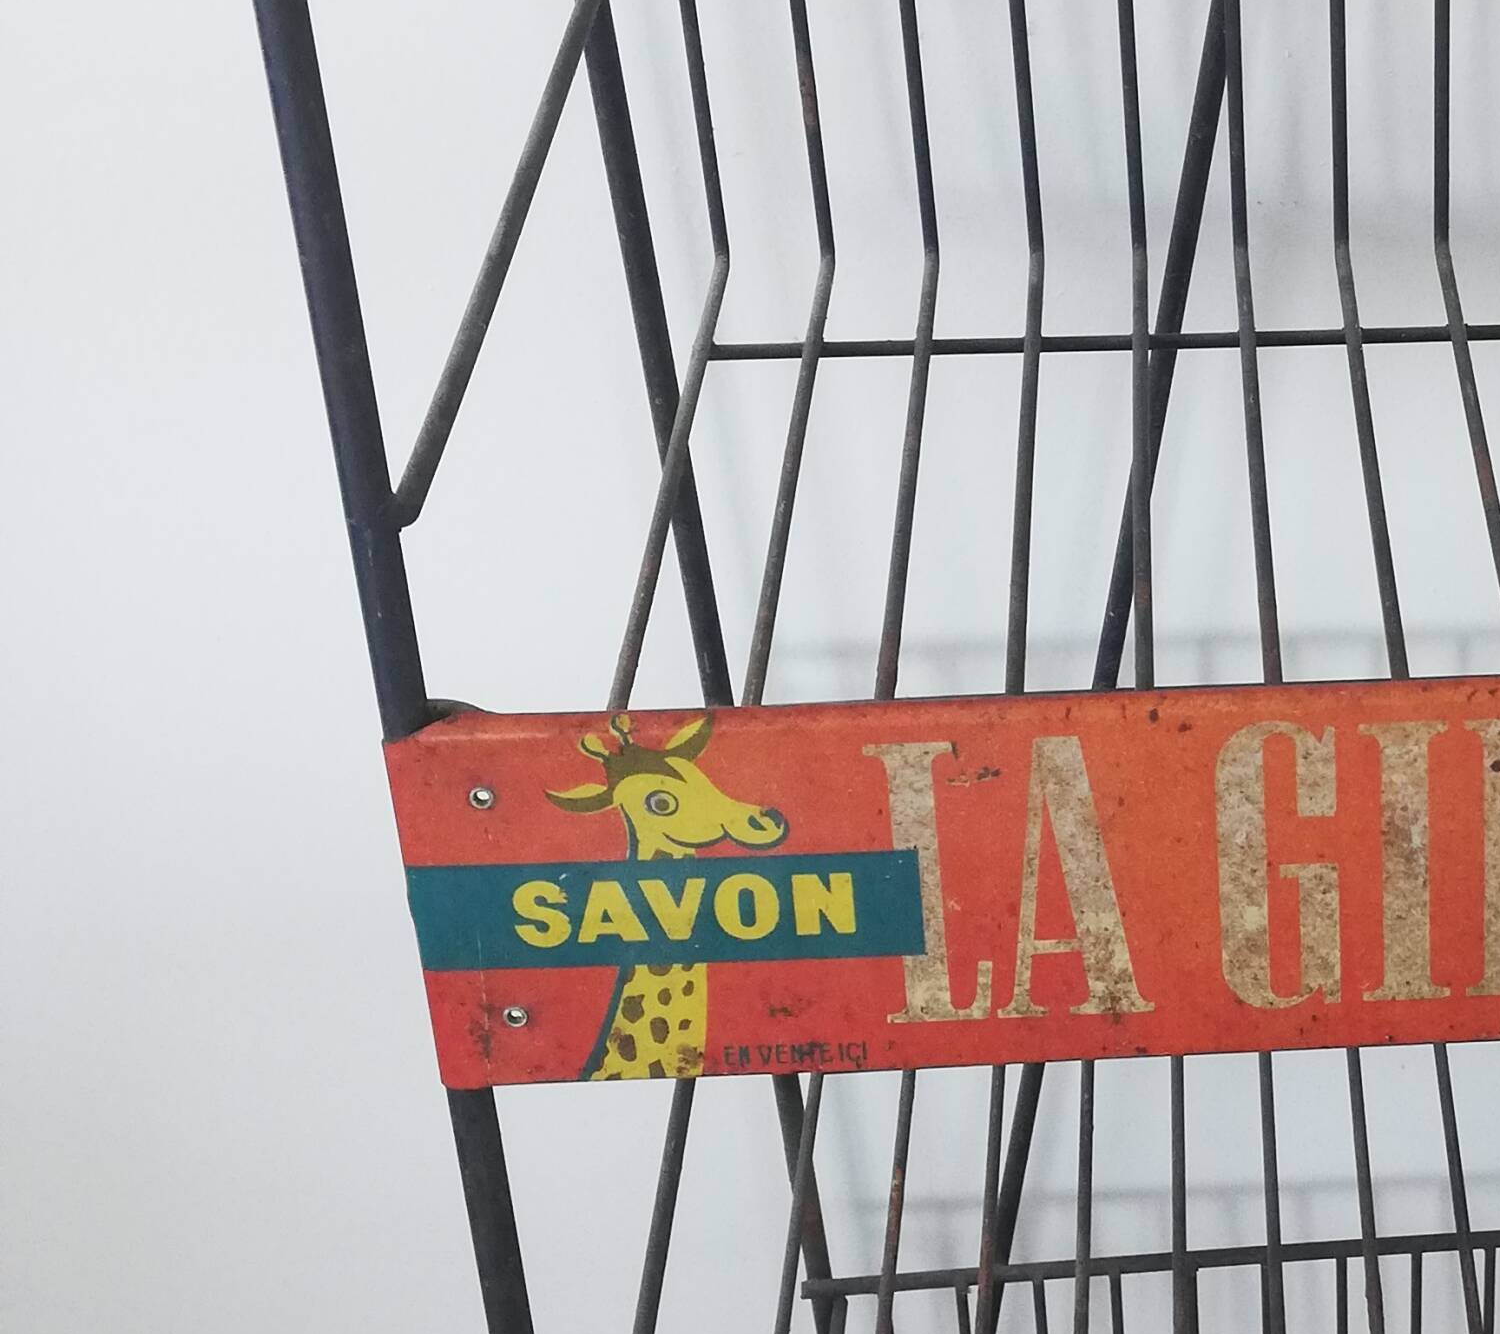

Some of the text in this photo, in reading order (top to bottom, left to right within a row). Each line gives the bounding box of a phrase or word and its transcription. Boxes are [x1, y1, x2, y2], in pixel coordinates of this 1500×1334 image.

[512, 871, 857, 949] SAVON
[861, 735, 1155, 1024] LA
[724, 1044, 749, 1066] EN
